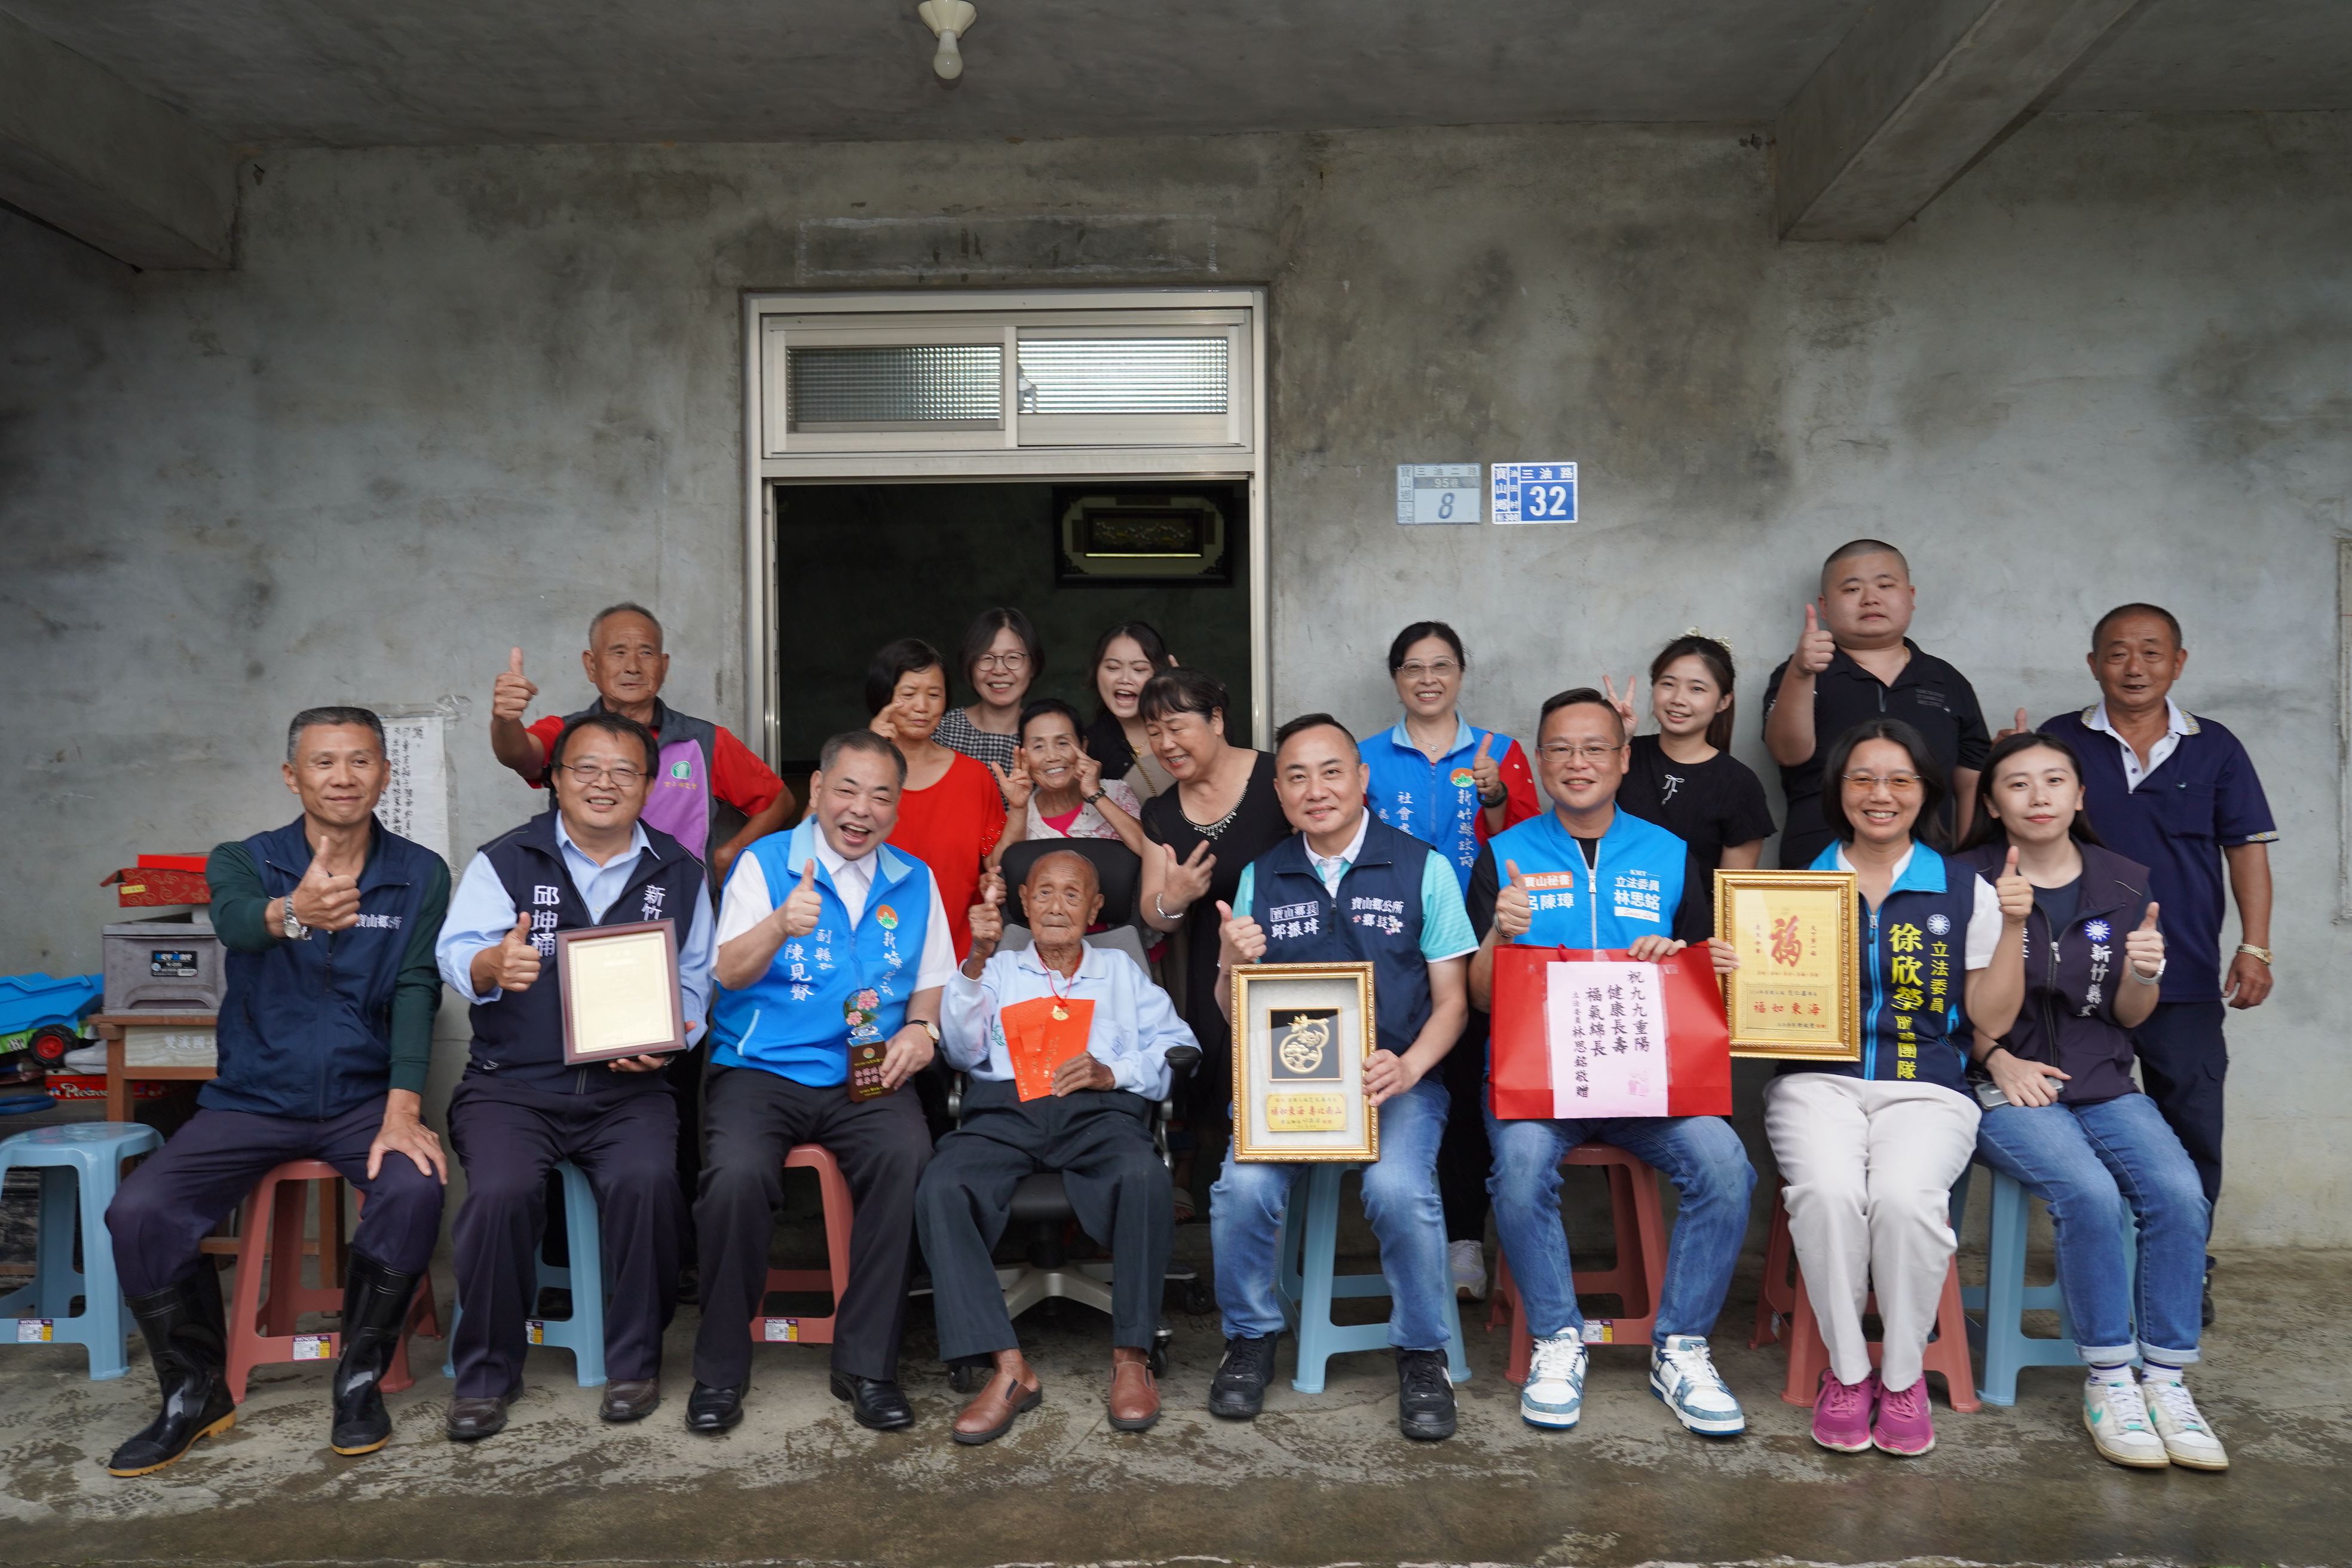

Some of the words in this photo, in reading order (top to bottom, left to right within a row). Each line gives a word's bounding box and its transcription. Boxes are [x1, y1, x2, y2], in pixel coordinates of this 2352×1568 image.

[1438, 492, 1455, 519] 8
[1529, 485, 1566, 516] 32
[1350, 896, 1404, 914] 寶山鄉公所
[1613, 889, 1661, 911] 林思銘
[1615, 876, 1660, 892] 立法委員
[530, 885, 560, 957] 邱坤桶
[784, 943, 815, 1002] 陳見賢
[1928, 941, 1950, 1014] 立法委員
[1586, 987, 1608, 1058] 福氣綿長
[1606, 984, 1629, 1054] 健康長壽
[1627, 970, 1650, 1052] 祝九九重陽
